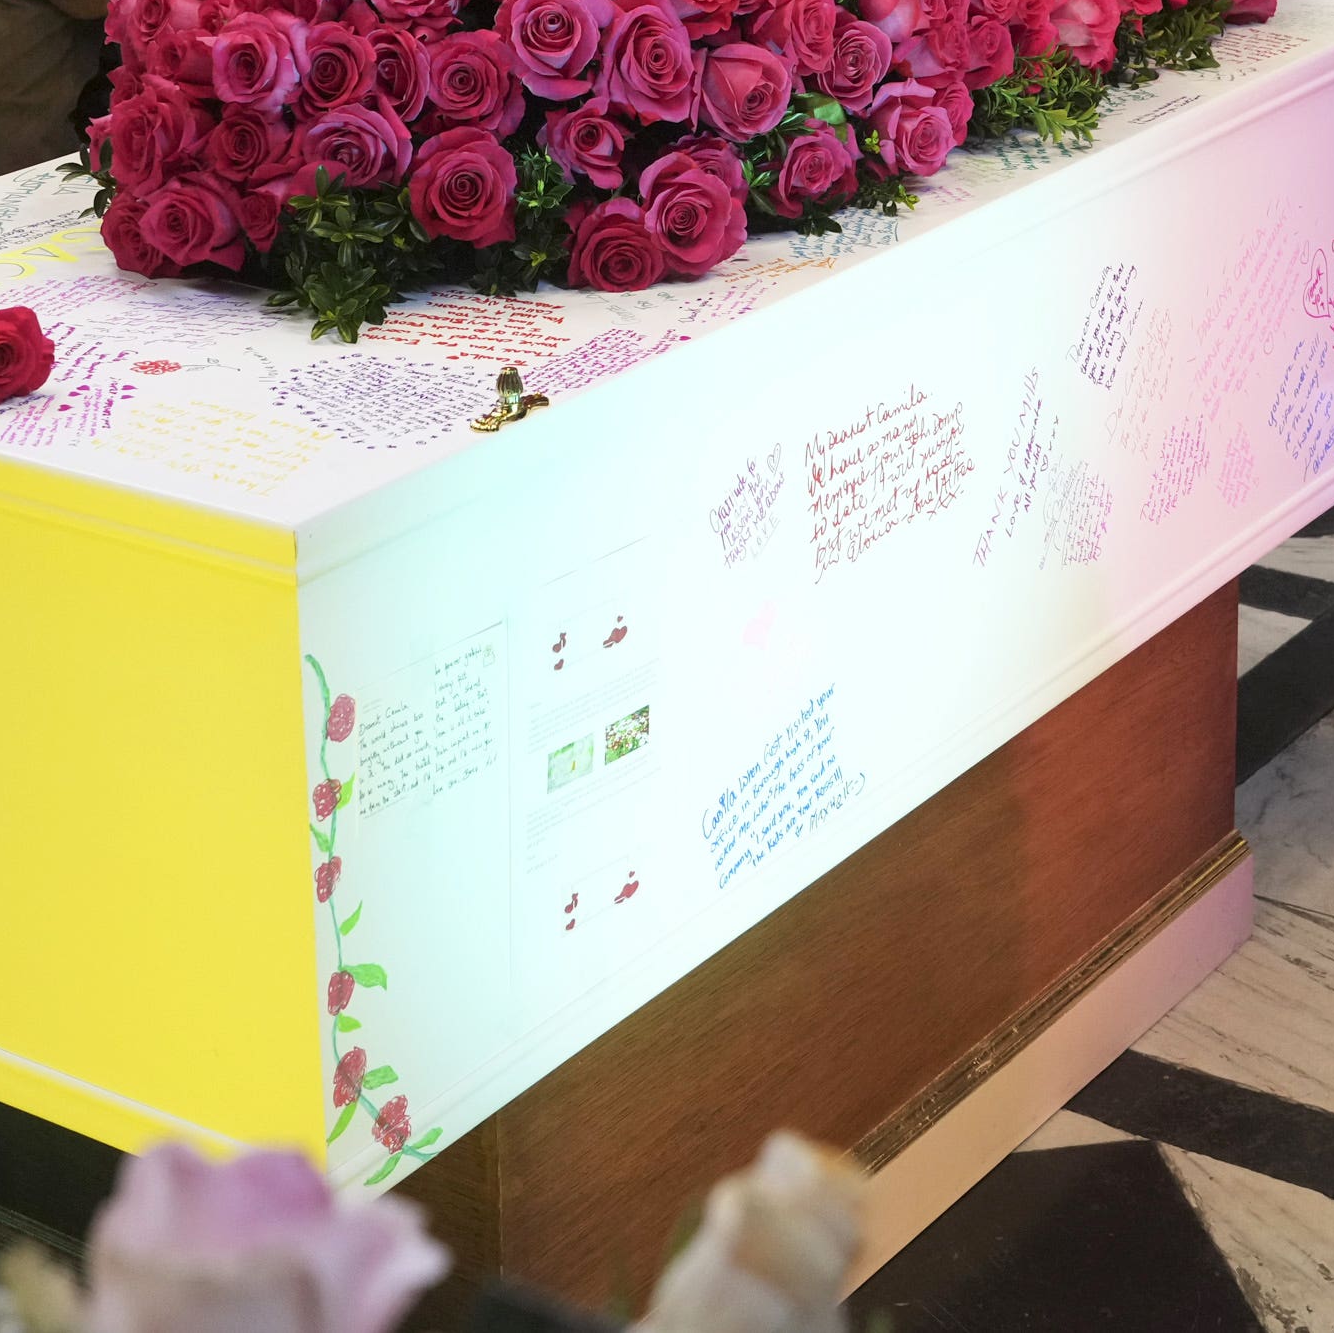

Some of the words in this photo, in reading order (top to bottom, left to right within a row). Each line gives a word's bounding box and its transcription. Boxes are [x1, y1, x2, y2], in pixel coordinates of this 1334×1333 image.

[448, 335, 513, 343] changed
[502, 348, 561, 357] Thank
[973, 485, 1009, 567] THANK
[1004, 427, 1021, 481] YOU
